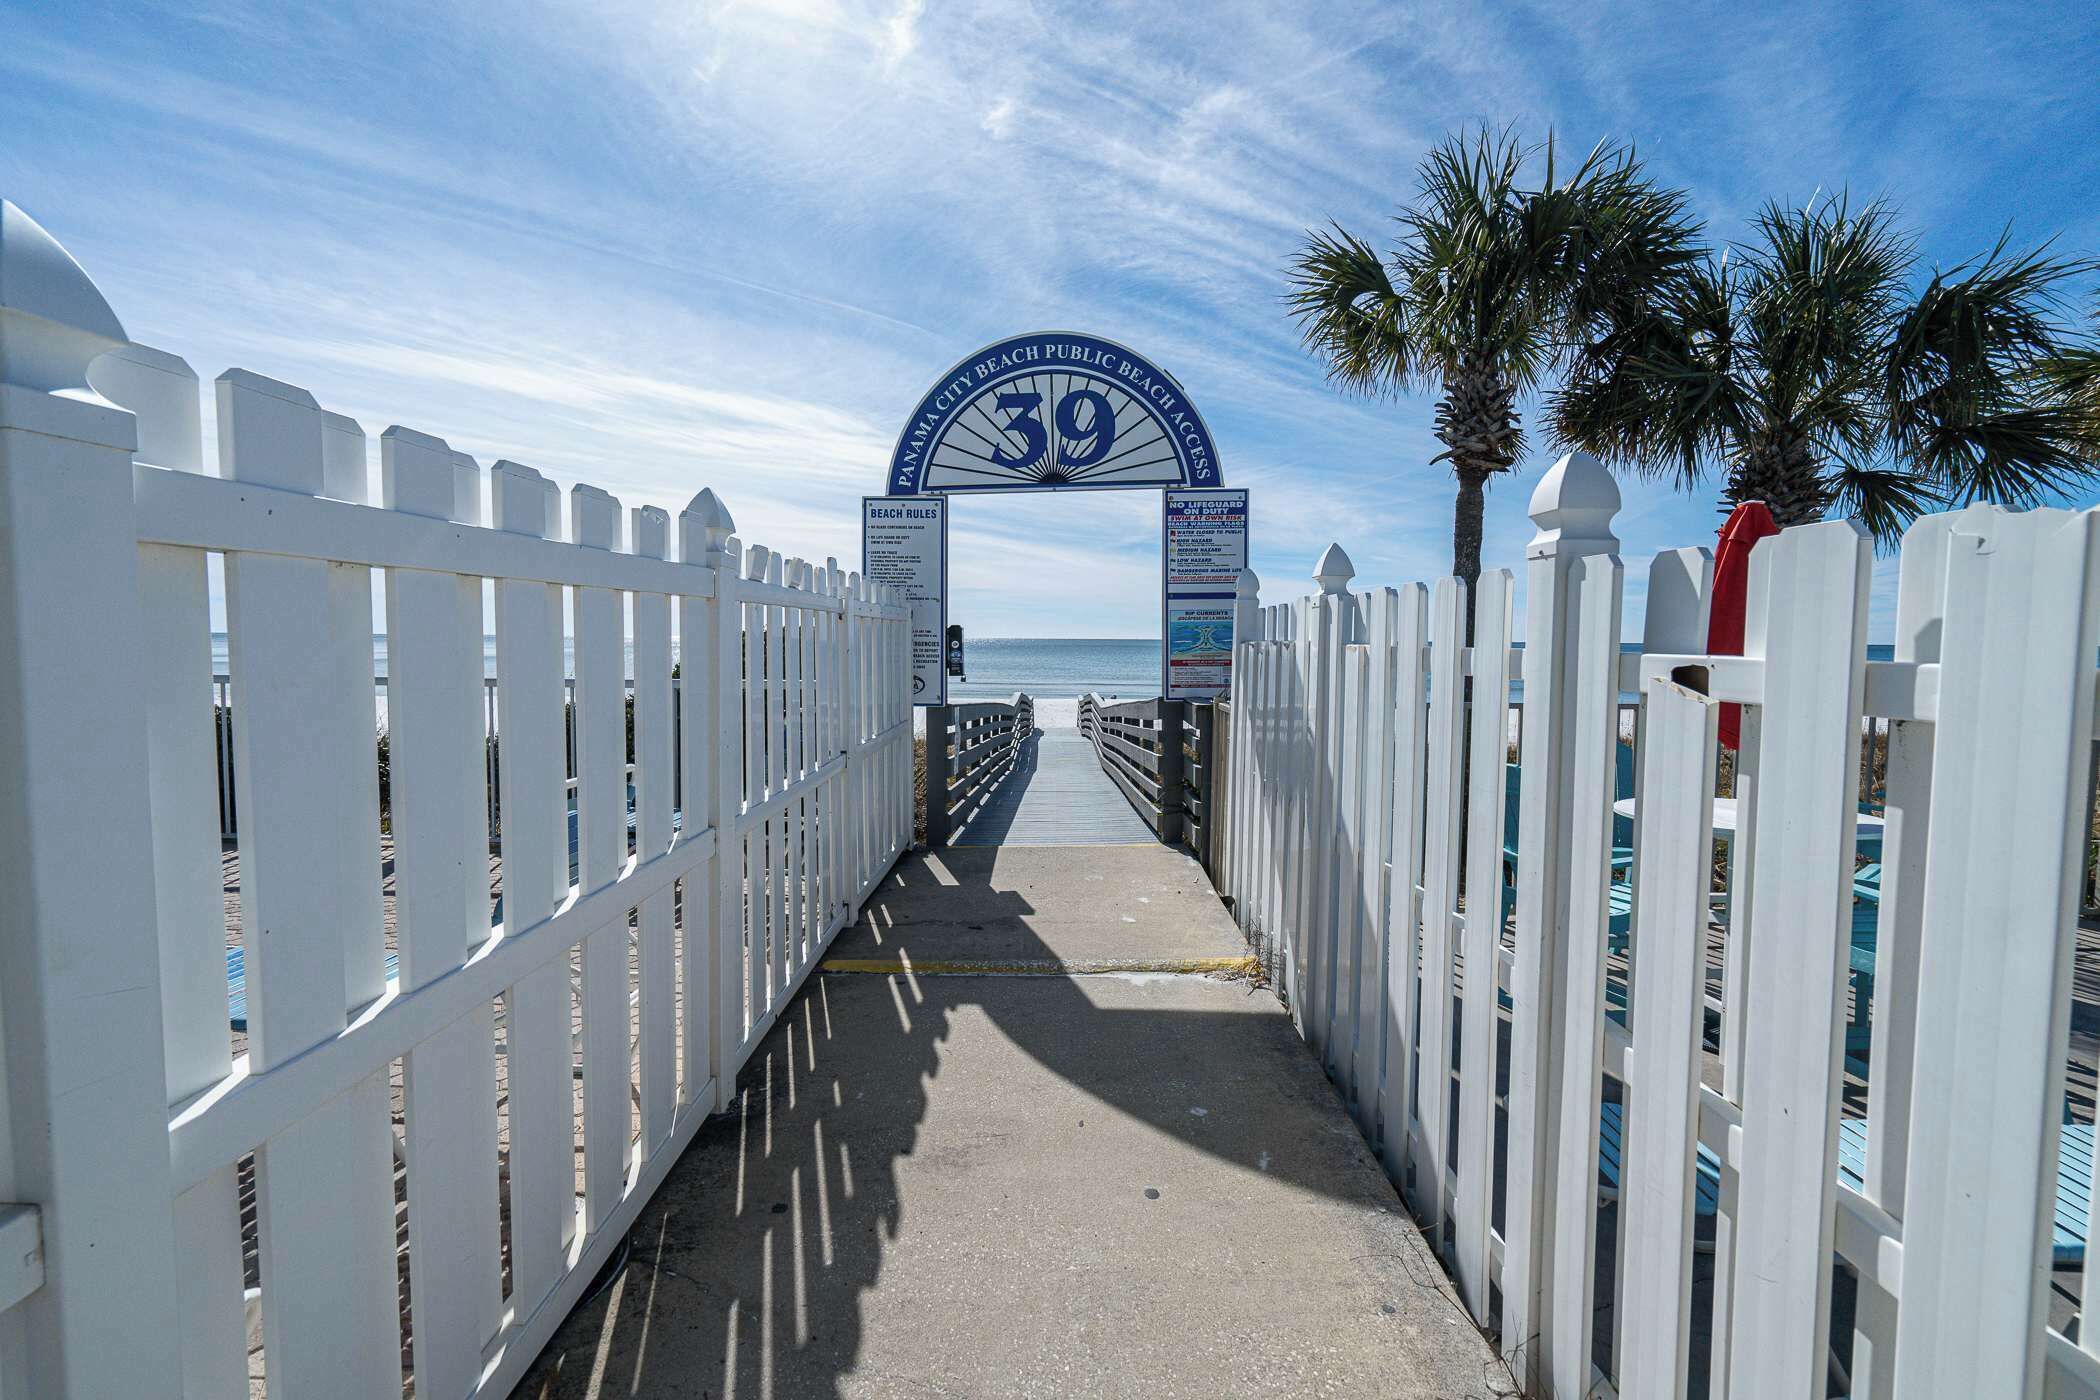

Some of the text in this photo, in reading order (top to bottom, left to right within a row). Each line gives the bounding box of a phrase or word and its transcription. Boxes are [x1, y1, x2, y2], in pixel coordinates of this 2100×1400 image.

[898, 344, 1211, 487] PANAMA CITY BEACH PUBLIC BEACH ACCESS
[990, 389, 1116, 469] 39
[870, 508, 937, 519] BEACH RULES
[1169, 501, 1185, 509] NO
